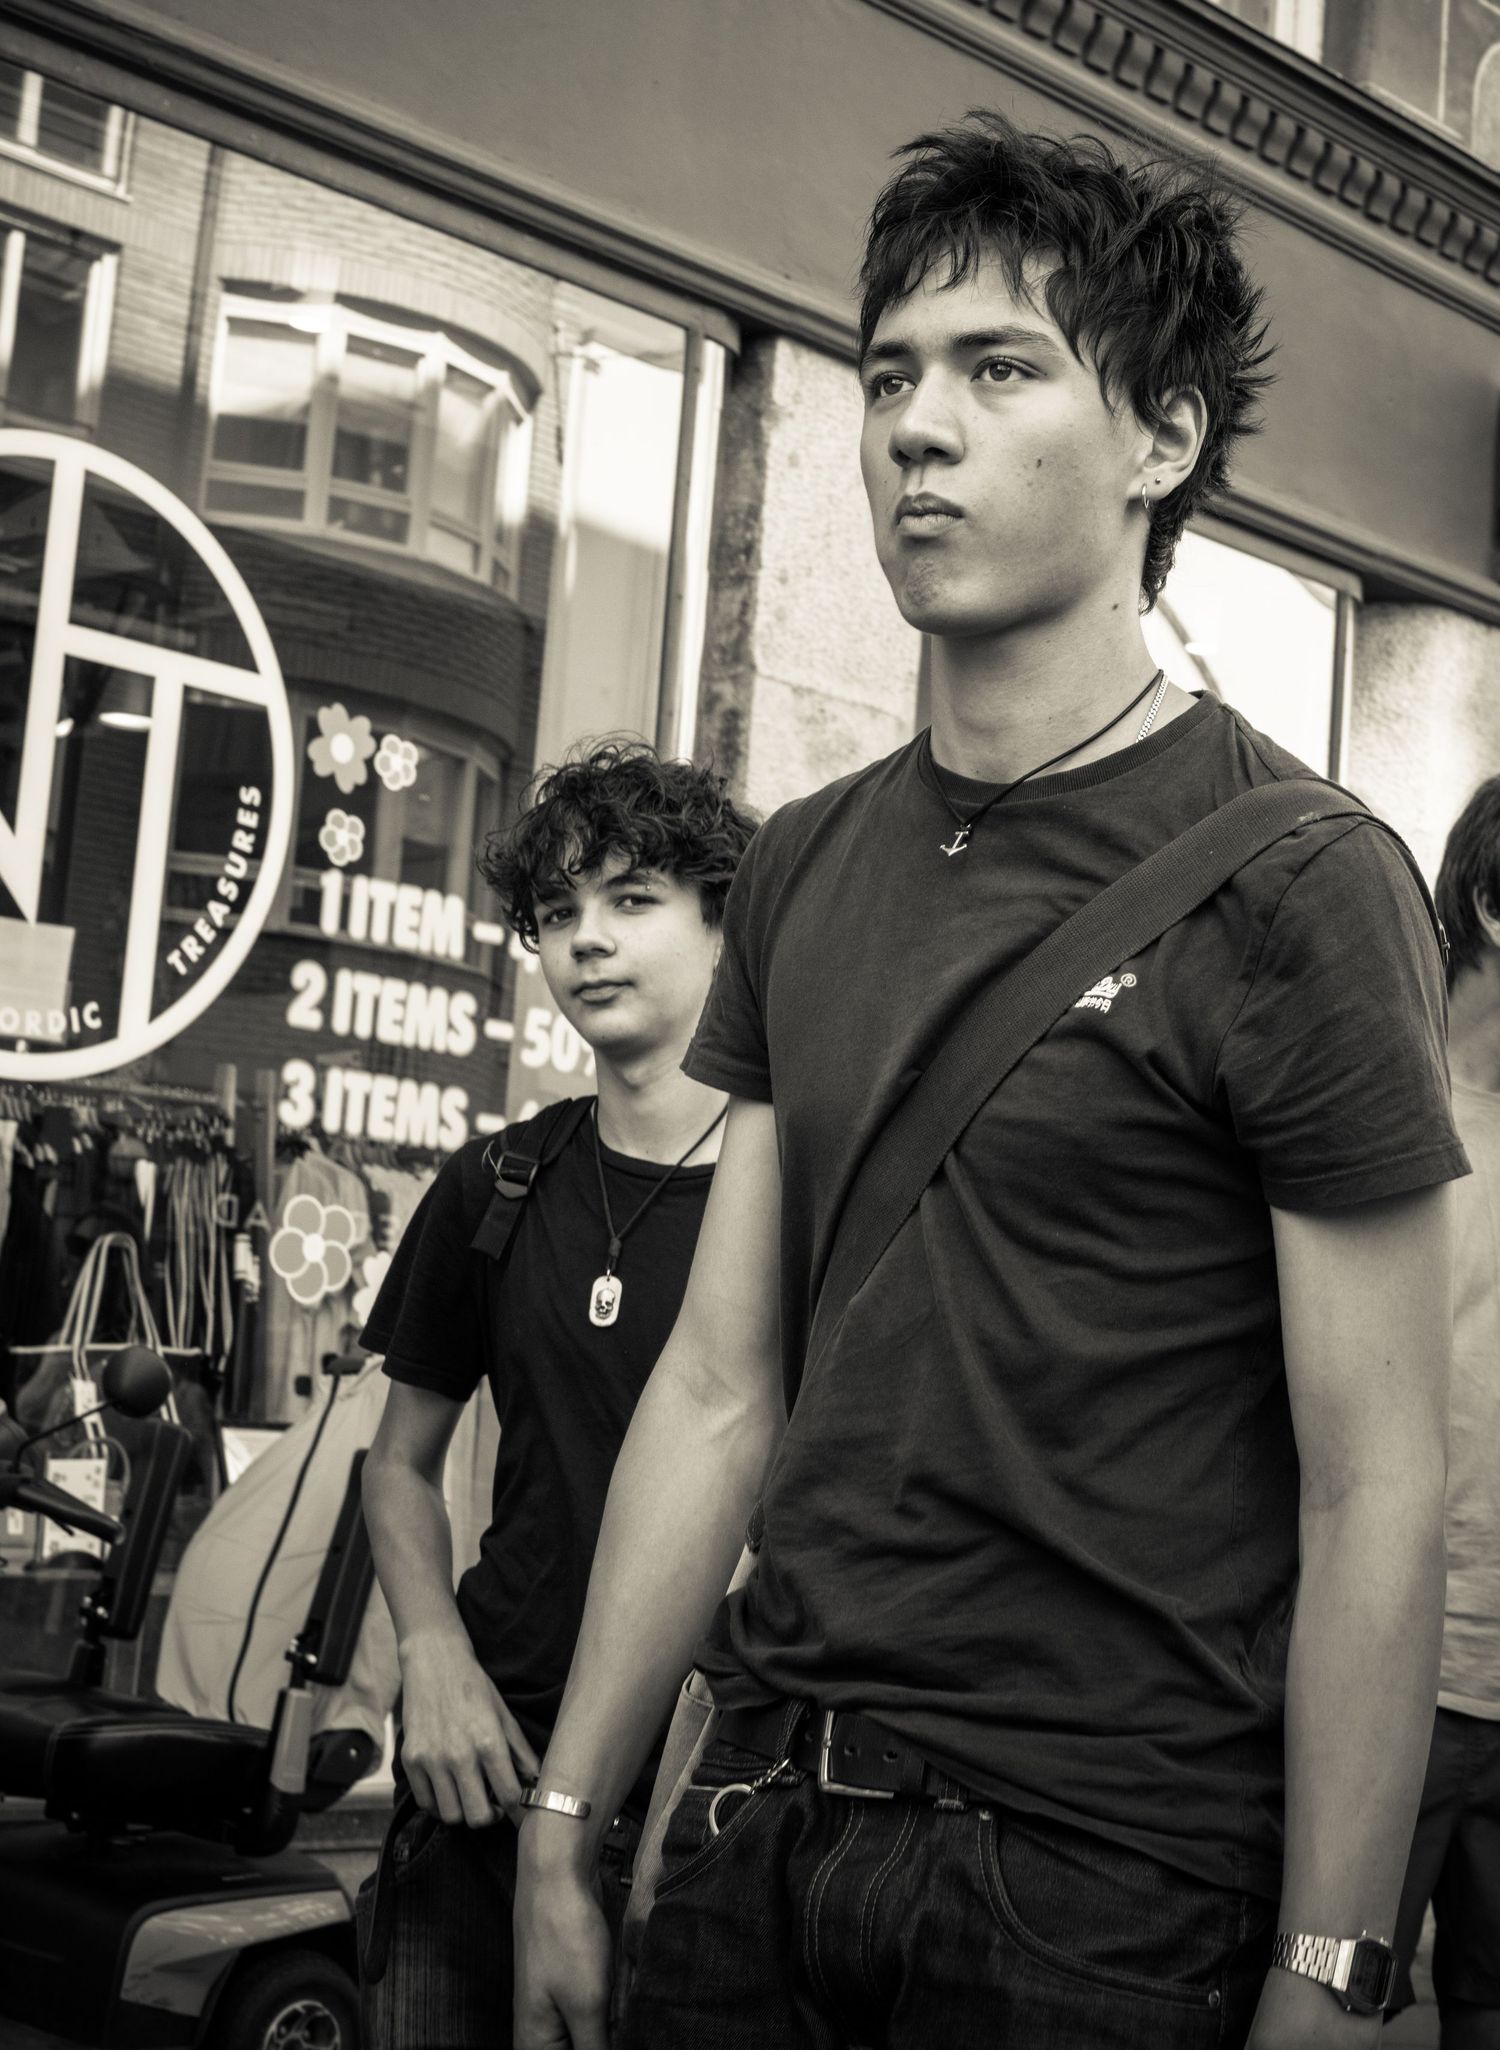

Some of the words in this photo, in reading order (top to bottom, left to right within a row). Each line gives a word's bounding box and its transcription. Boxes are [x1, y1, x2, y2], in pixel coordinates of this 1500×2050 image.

[167, 785, 262, 976] TREASURES
[319, 869, 344, 938] 1
[348, 874, 466, 963] ITEM
[286, 960, 328, 1031] 2
[331, 967, 478, 1057] ITEMS
[520, 1006, 598, 1076] 50
[277, 1059, 317, 1130] 3
[321, 1065, 469, 1152] ITEMS
